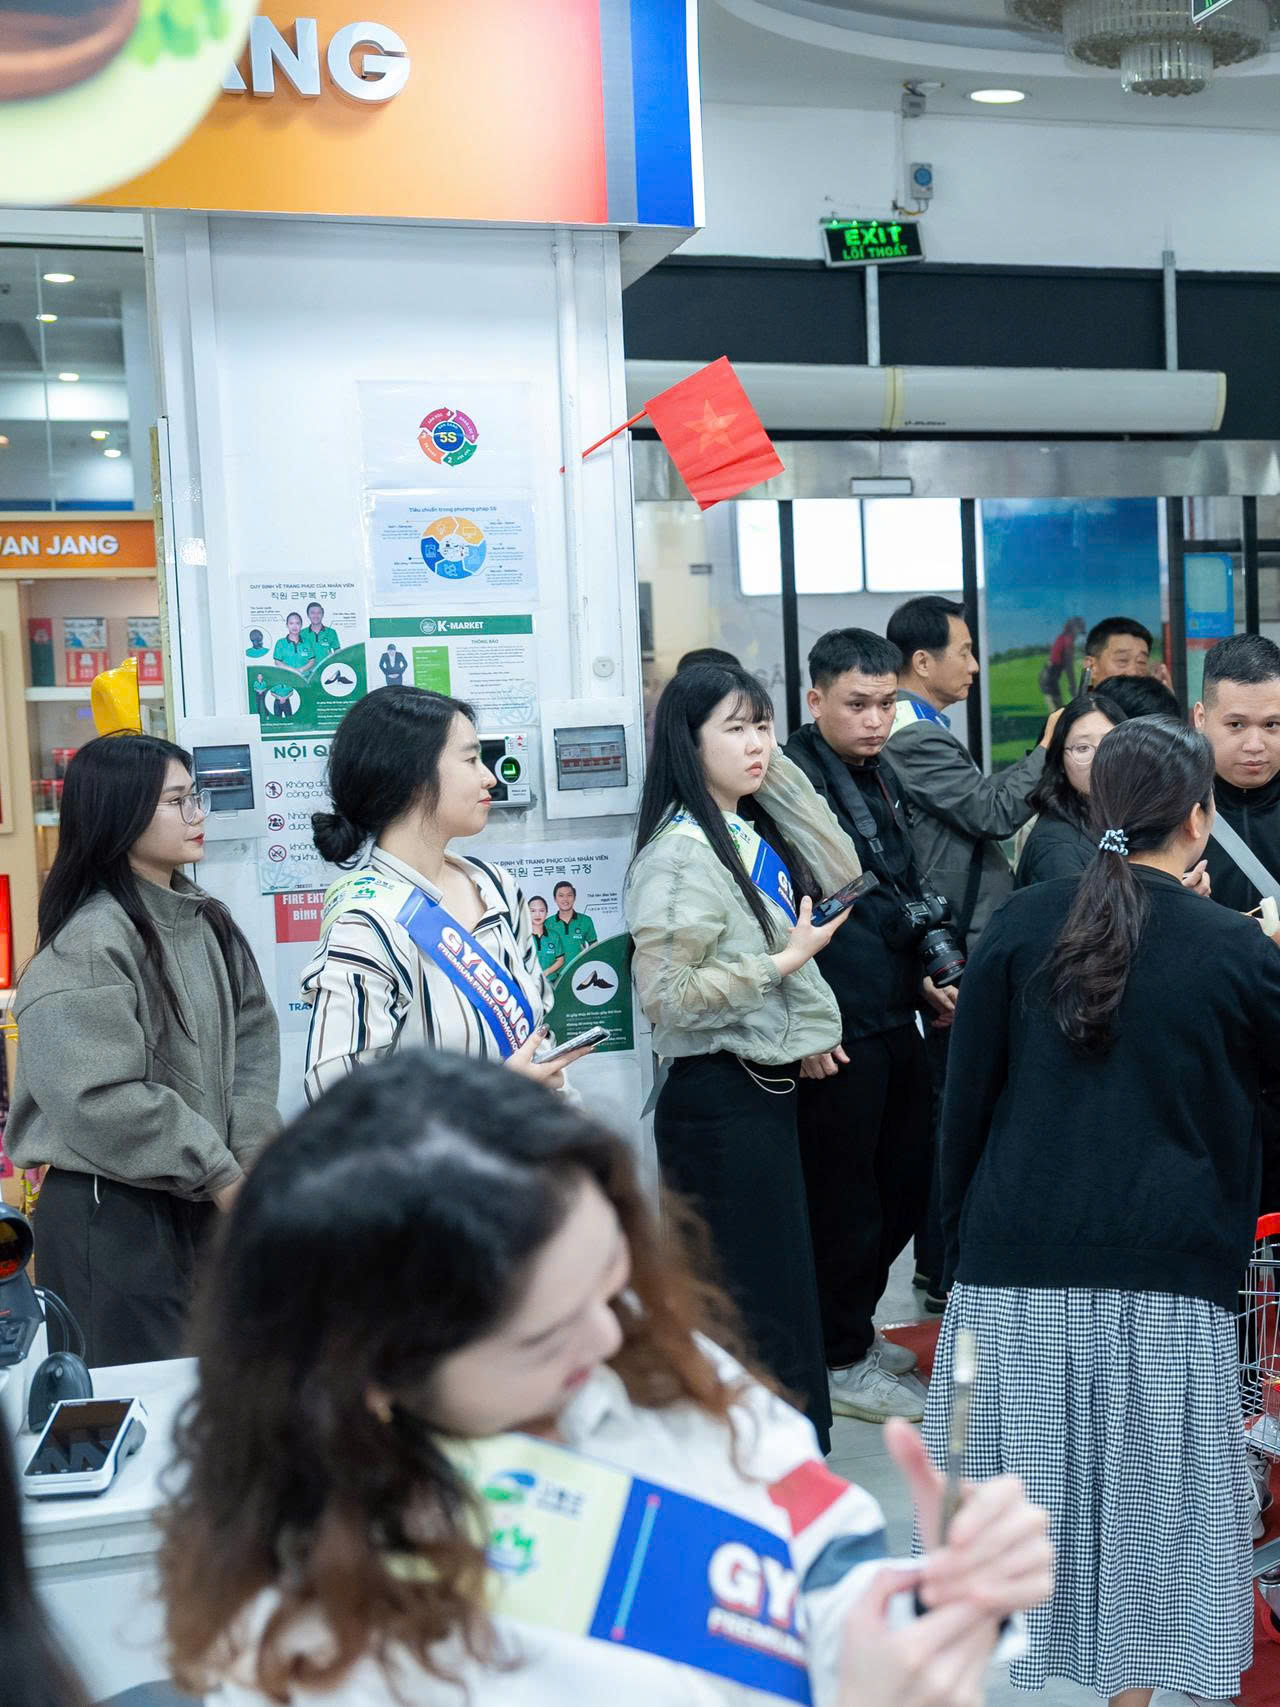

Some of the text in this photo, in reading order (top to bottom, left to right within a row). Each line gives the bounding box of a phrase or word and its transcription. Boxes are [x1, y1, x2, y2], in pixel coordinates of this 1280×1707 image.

[223, 15, 411, 104] NG
[843, 225, 902, 246] EXIT
[440, 431, 457, 443] 5S
[0, 534, 119, 556] AN JANG
[437, 620, 484, 632] K-MARKET
[274, 742, 307, 762] NỘI
[571, 863, 592, 874] 규정
[283, 892, 324, 904] FIRE EXT
[441, 927, 530, 1045] GYEONG
[289, 1003, 309, 1011] TRA
[493, 1003, 519, 1050] PROMOTIO
[708, 1541, 799, 1628] GY
